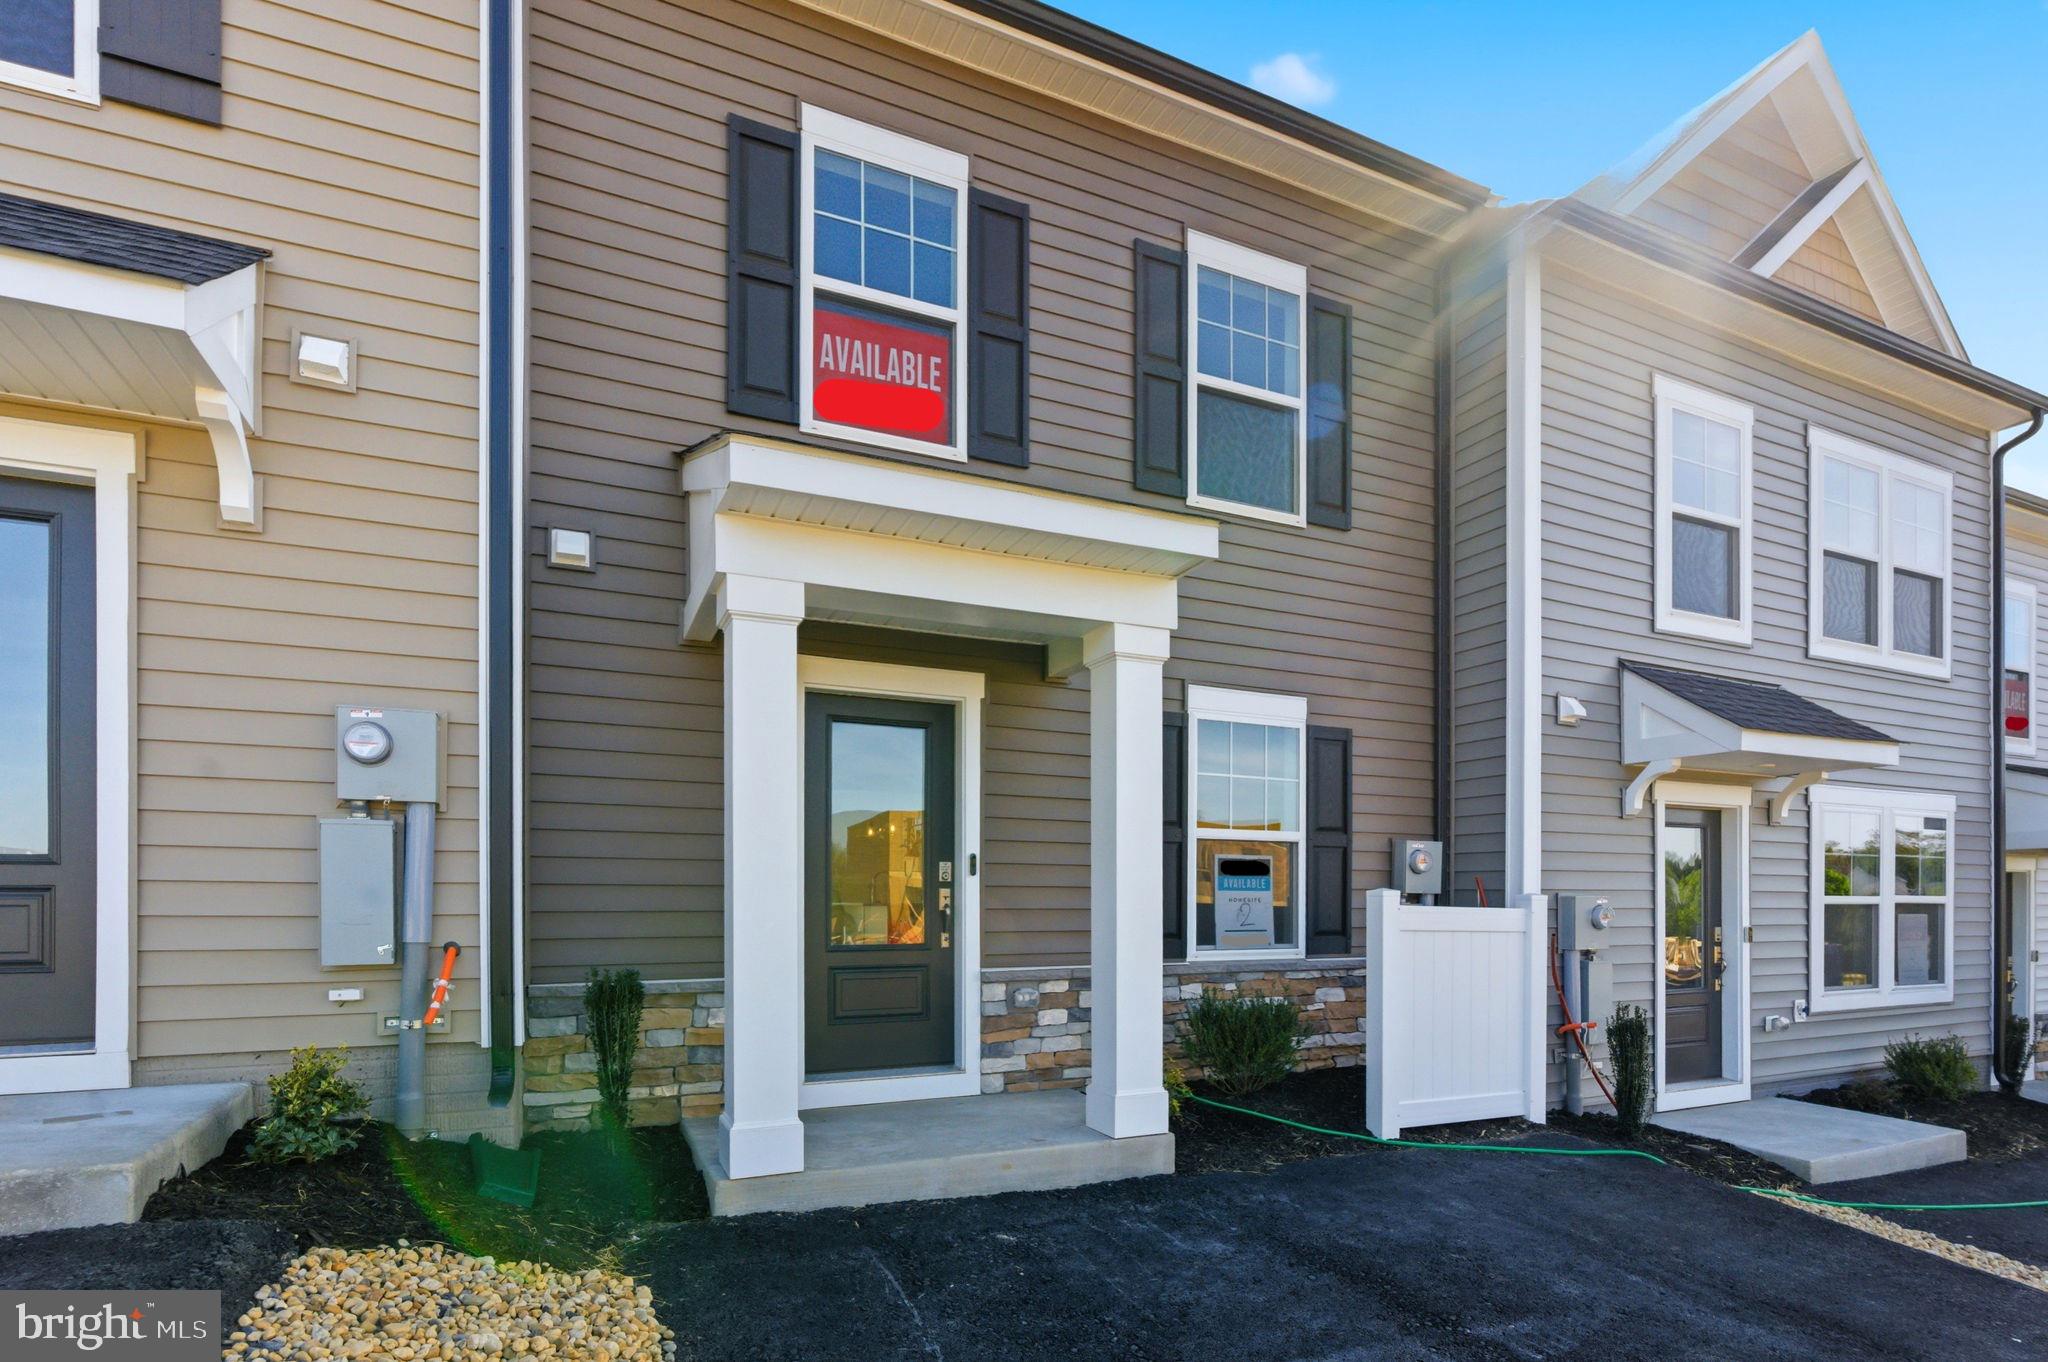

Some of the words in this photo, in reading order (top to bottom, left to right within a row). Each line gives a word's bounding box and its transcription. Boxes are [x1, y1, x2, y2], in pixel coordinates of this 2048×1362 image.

[819, 333, 942, 393] AVAILABLE
[2005, 690, 2026, 712] ILABLE
[1223, 878, 1267, 889] AVAILABLE
[1239, 902, 1256, 927] 2
